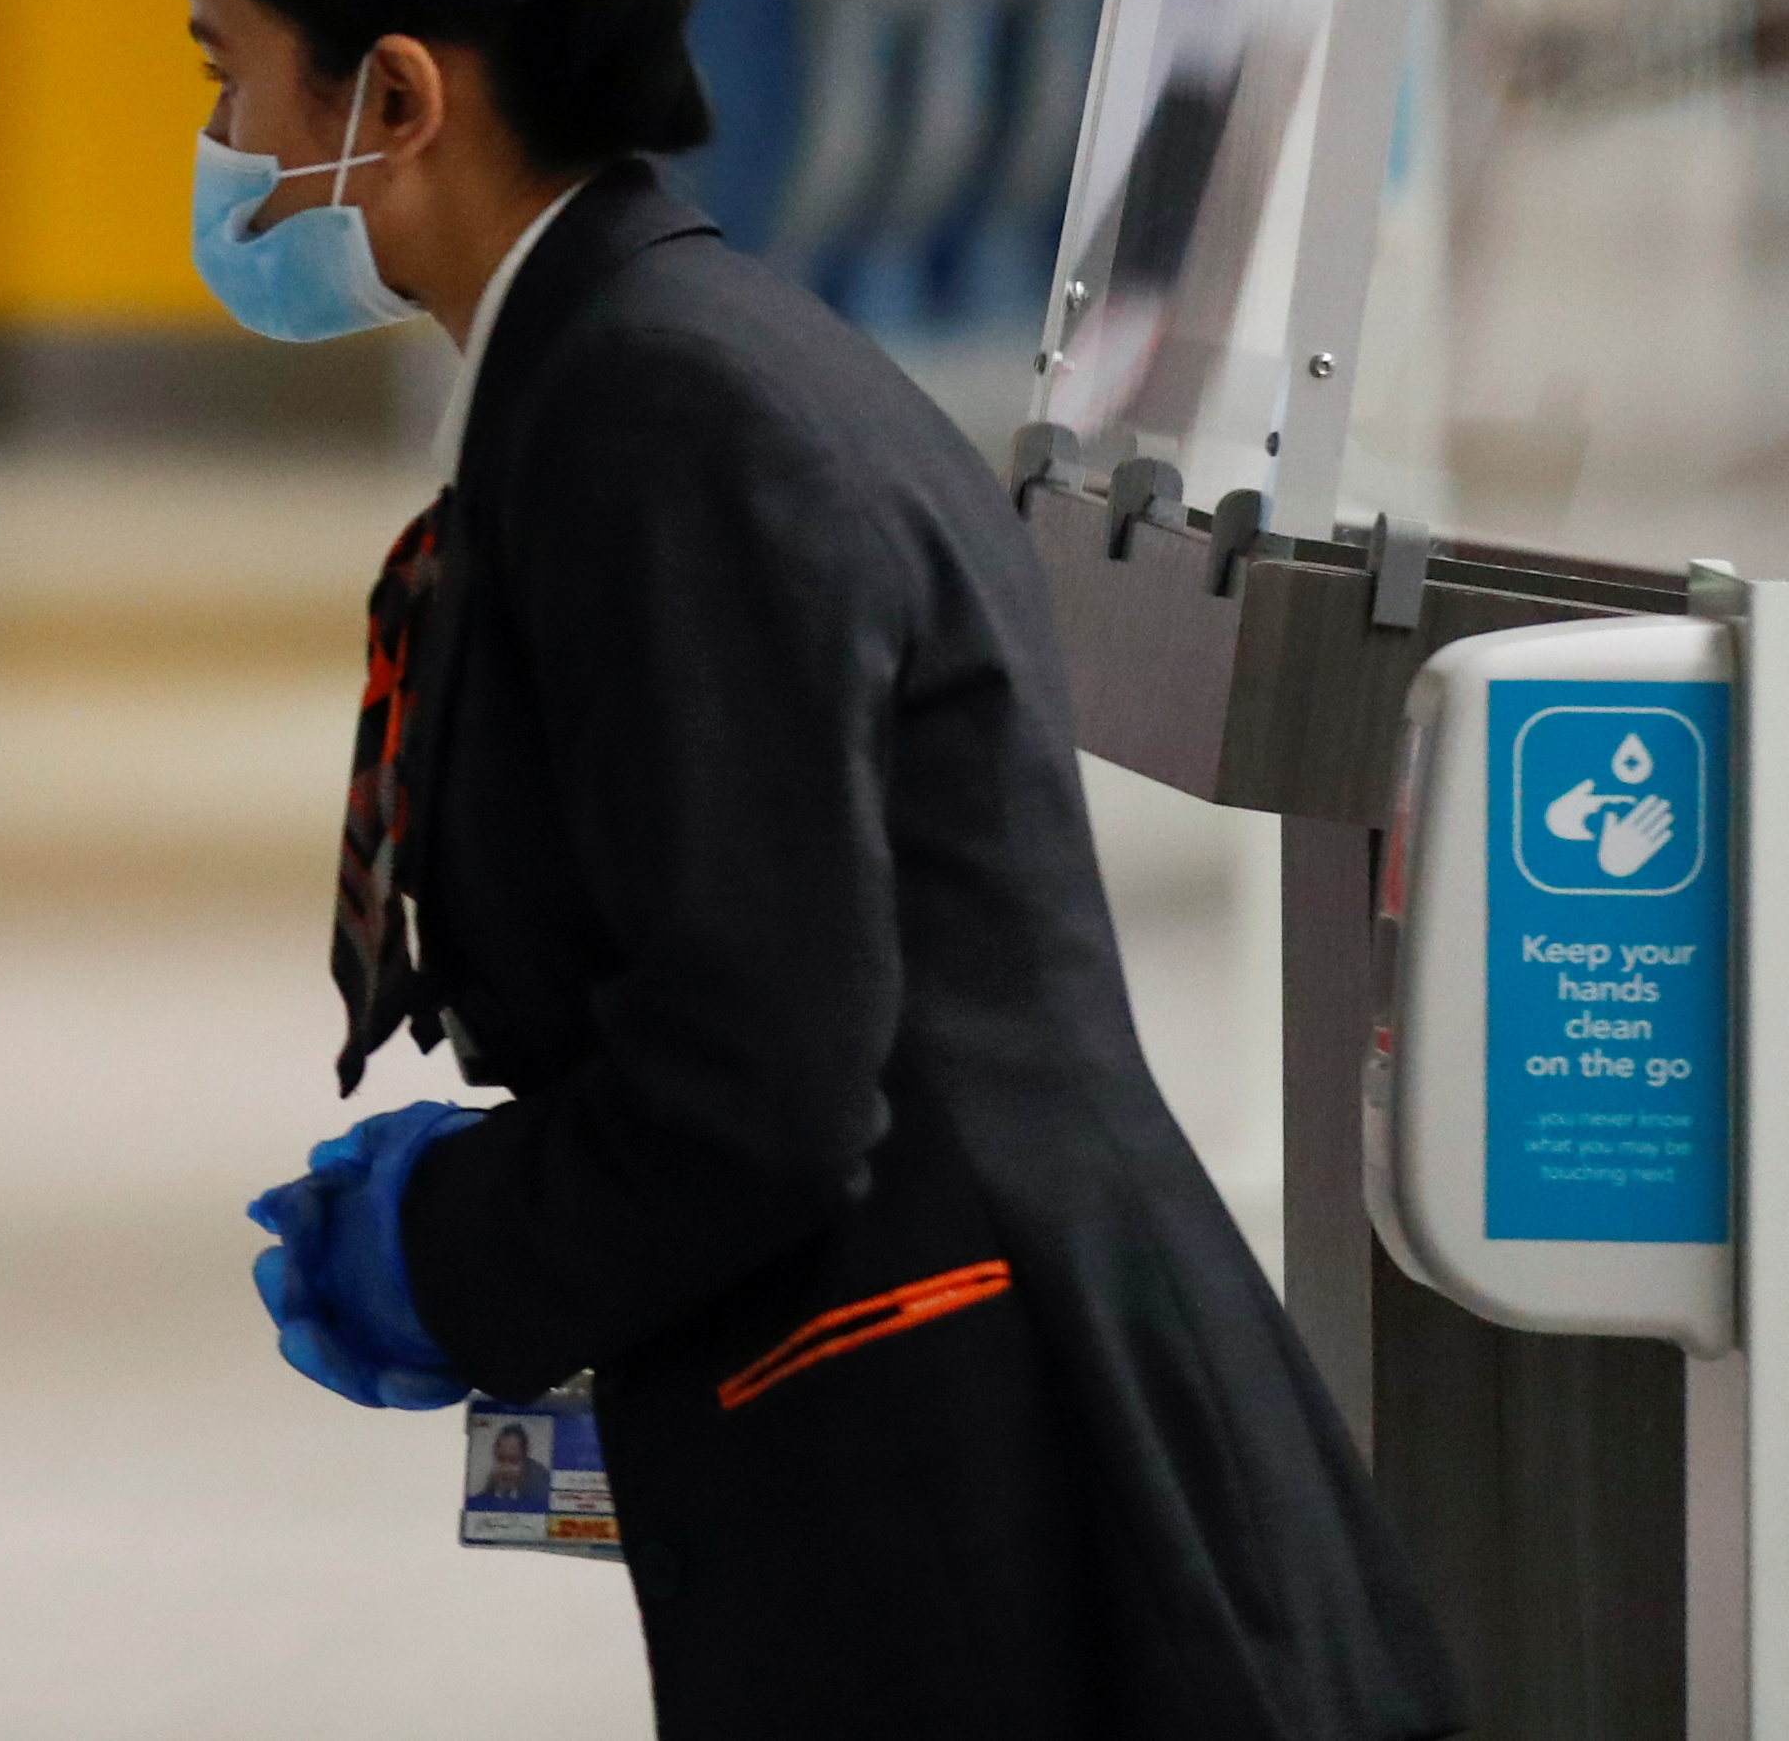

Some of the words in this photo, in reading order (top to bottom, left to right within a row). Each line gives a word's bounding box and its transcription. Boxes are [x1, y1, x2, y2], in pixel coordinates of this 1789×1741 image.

[1522, 934, 1612, 971] Keep
[1620, 943, 1697, 972] your
[1558, 971, 1661, 1002] hands
[1564, 1009, 1653, 1040] clean
[1525, 1055, 1570, 1076] on
[1578, 1048, 1635, 1078] the
[1645, 1057, 1693, 1088] go
[1579, 1112, 1635, 1127] never
[1637, 1109, 1694, 1129] know
[1524, 1137, 1573, 1153] what
[1578, 1140, 1615, 1159] you
[1618, 1140, 1661, 1159] may
[1663, 1137, 1693, 1156] be
[1539, 1164, 1627, 1187] touching
